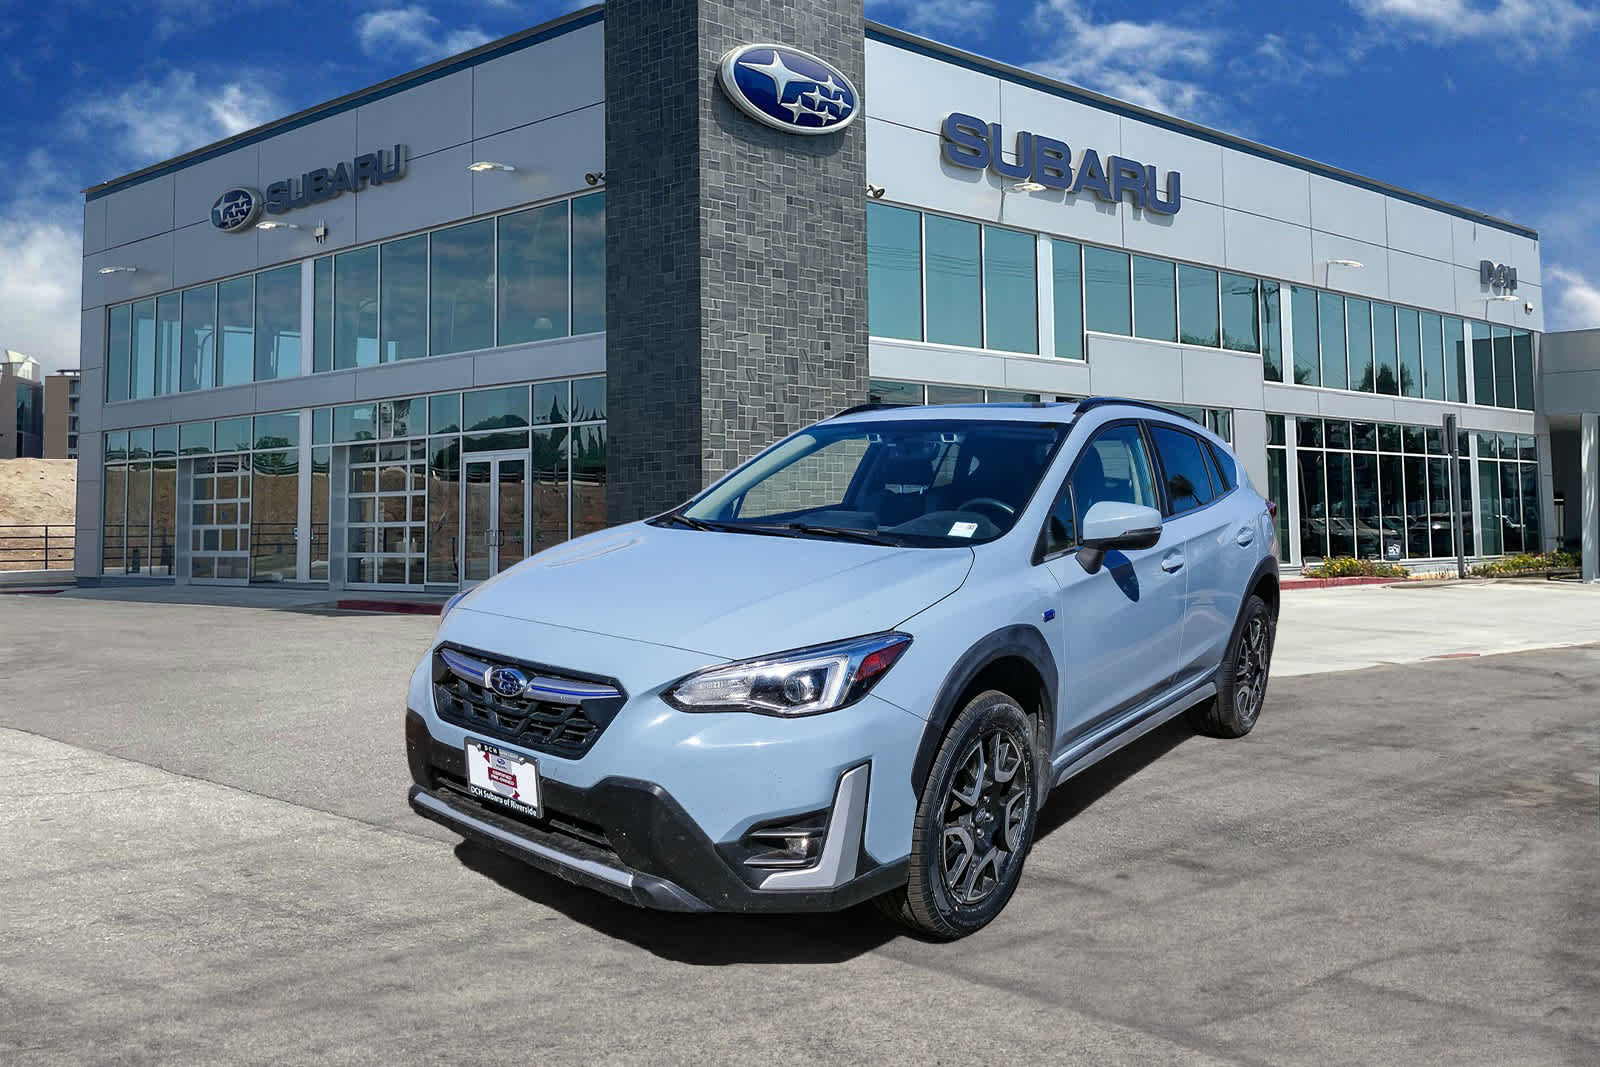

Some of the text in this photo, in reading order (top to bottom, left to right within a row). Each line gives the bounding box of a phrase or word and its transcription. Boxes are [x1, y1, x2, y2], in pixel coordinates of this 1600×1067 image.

[266, 144, 406, 215] SUBARU
[941, 112, 1181, 215] SUBARU
[471, 785, 483, 797] DCH
[503, 798, 510, 807] of
[510, 800, 537, 817] Riverside
